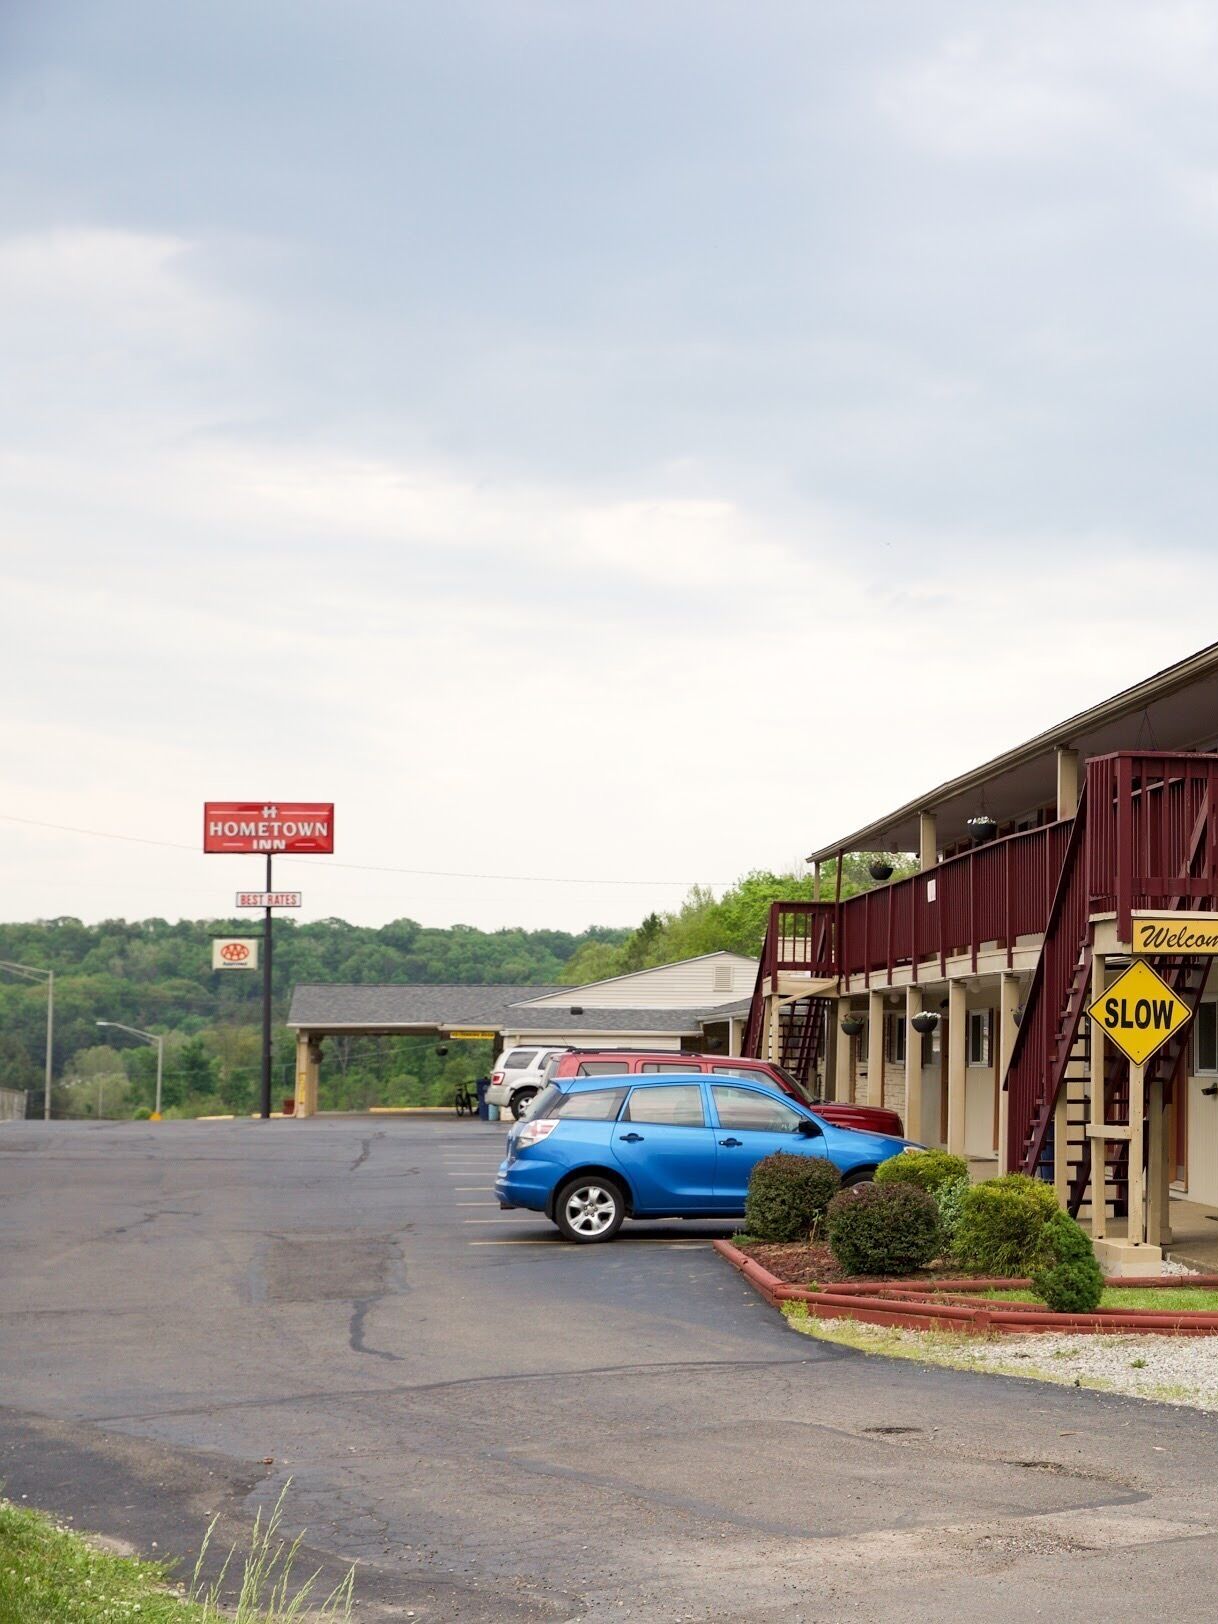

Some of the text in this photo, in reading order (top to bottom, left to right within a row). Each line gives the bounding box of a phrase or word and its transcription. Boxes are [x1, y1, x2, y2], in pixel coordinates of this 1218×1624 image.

[209, 821, 328, 836] HOMETOWN
[252, 839, 286, 849] INN
[240, 895, 297, 905] BEST RATES
[1104, 998, 1174, 1029] SLOW
